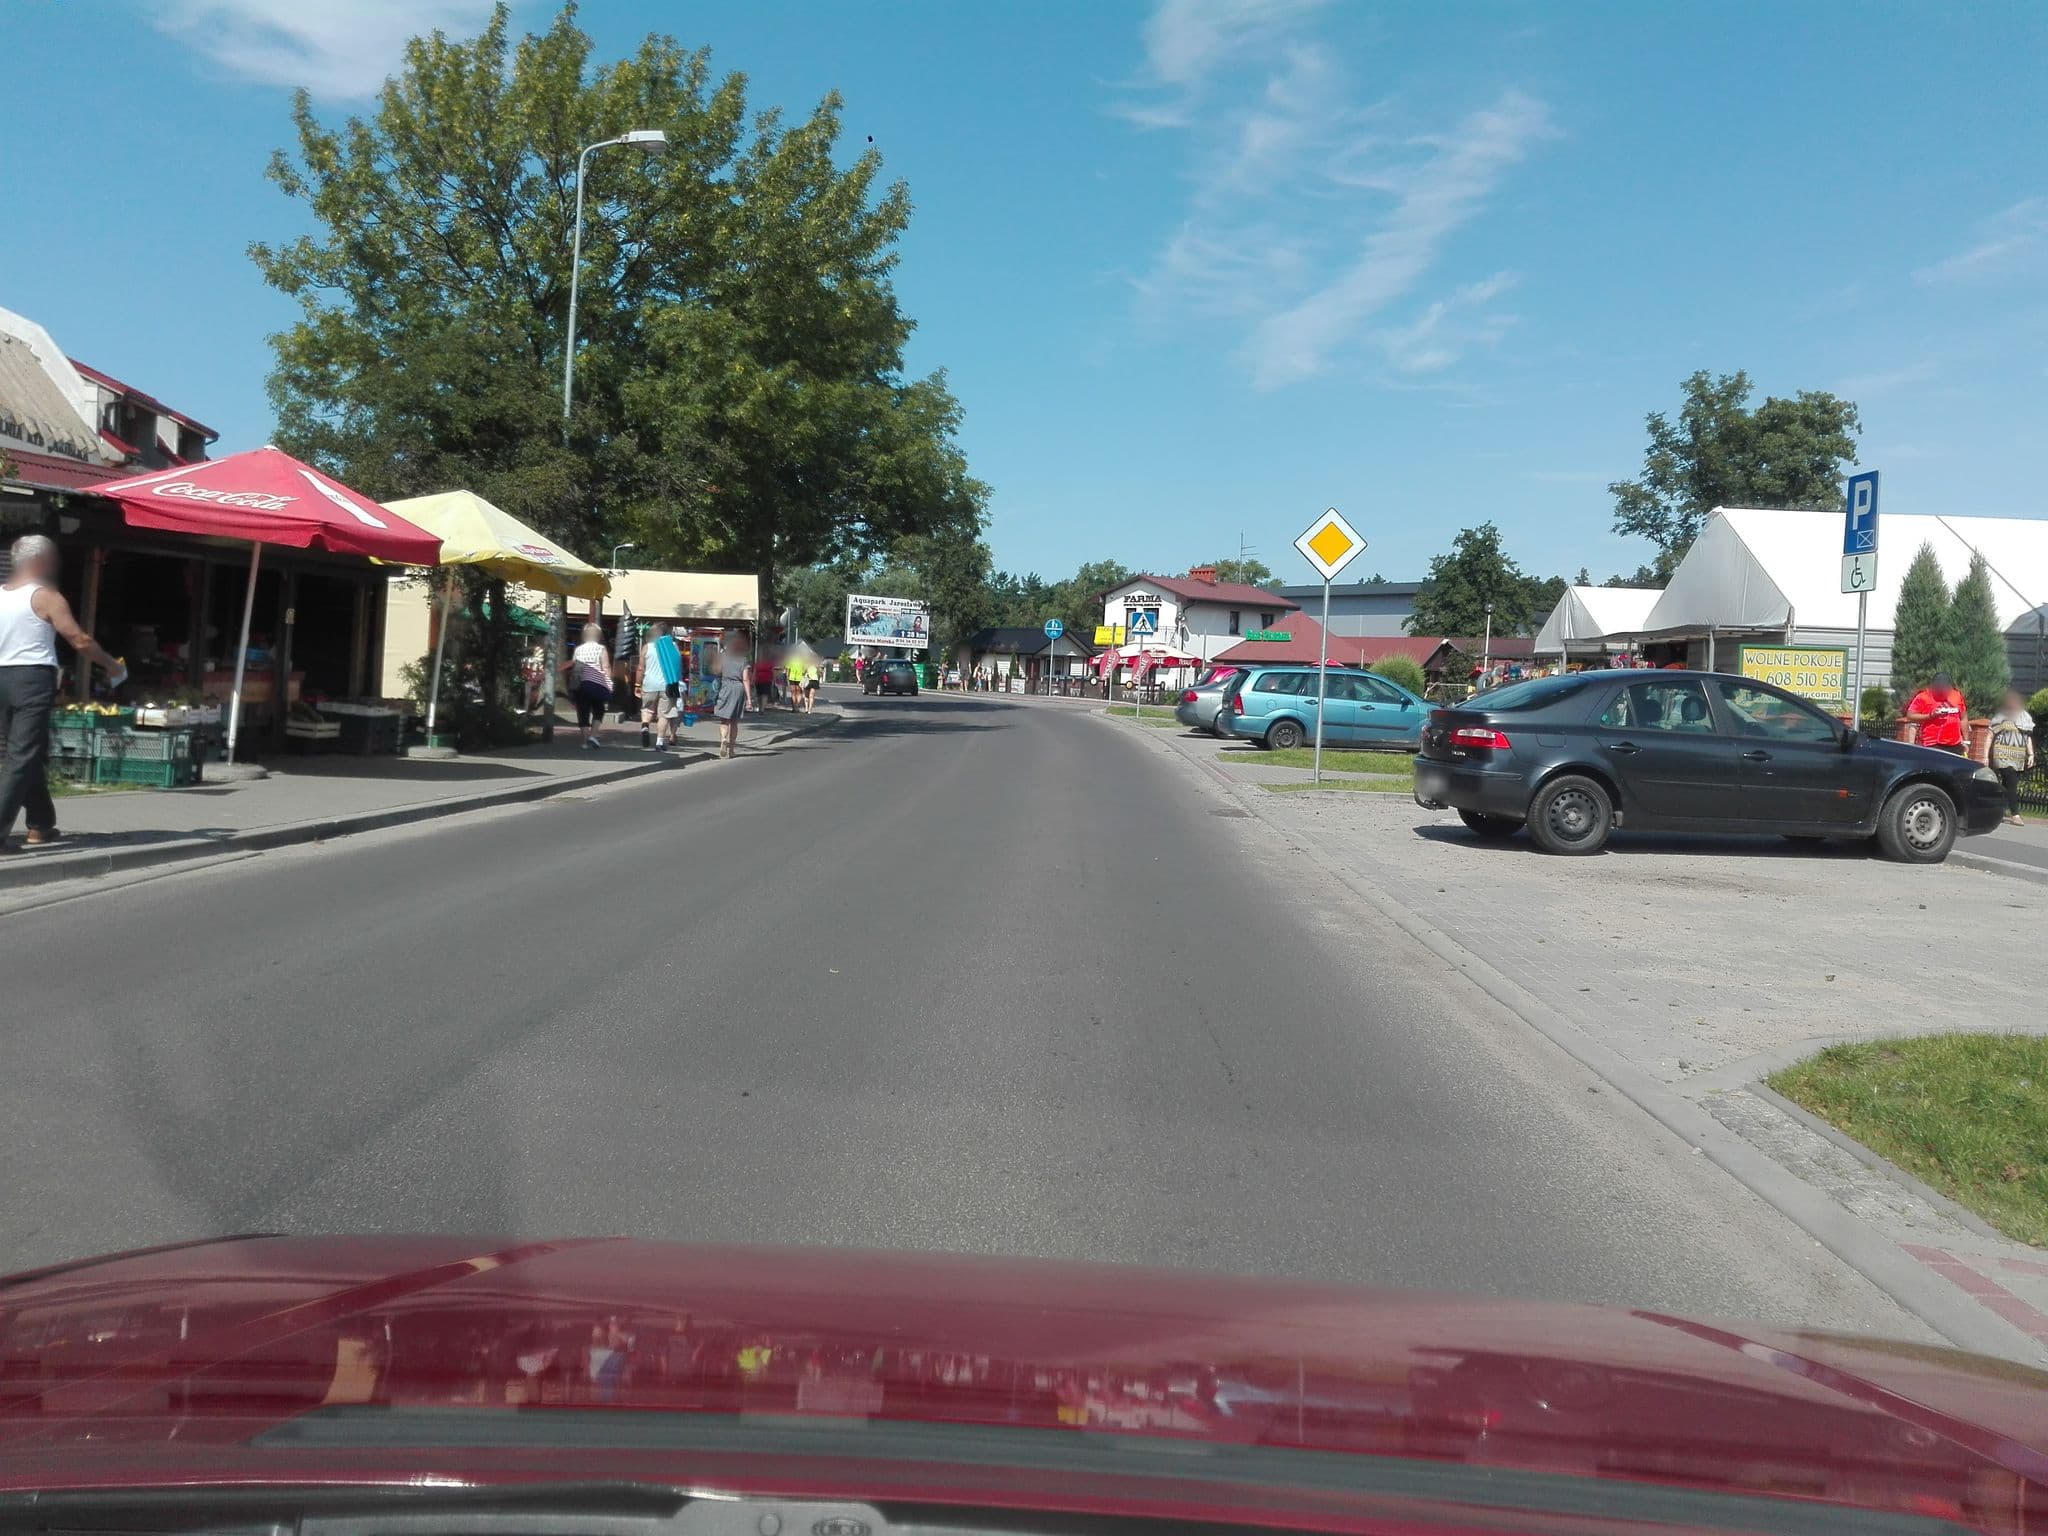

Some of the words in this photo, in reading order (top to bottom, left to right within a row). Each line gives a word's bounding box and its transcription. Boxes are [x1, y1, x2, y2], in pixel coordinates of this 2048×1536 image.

[152, 482, 299, 511] Coca-Cola
[1852, 480, 1872, 530] P
[1745, 652, 1790, 666] WOLNE
[1793, 654, 1841, 667] POKOJE
[1767, 671, 1792, 686] 608
[1796, 672, 1817, 687] 510
